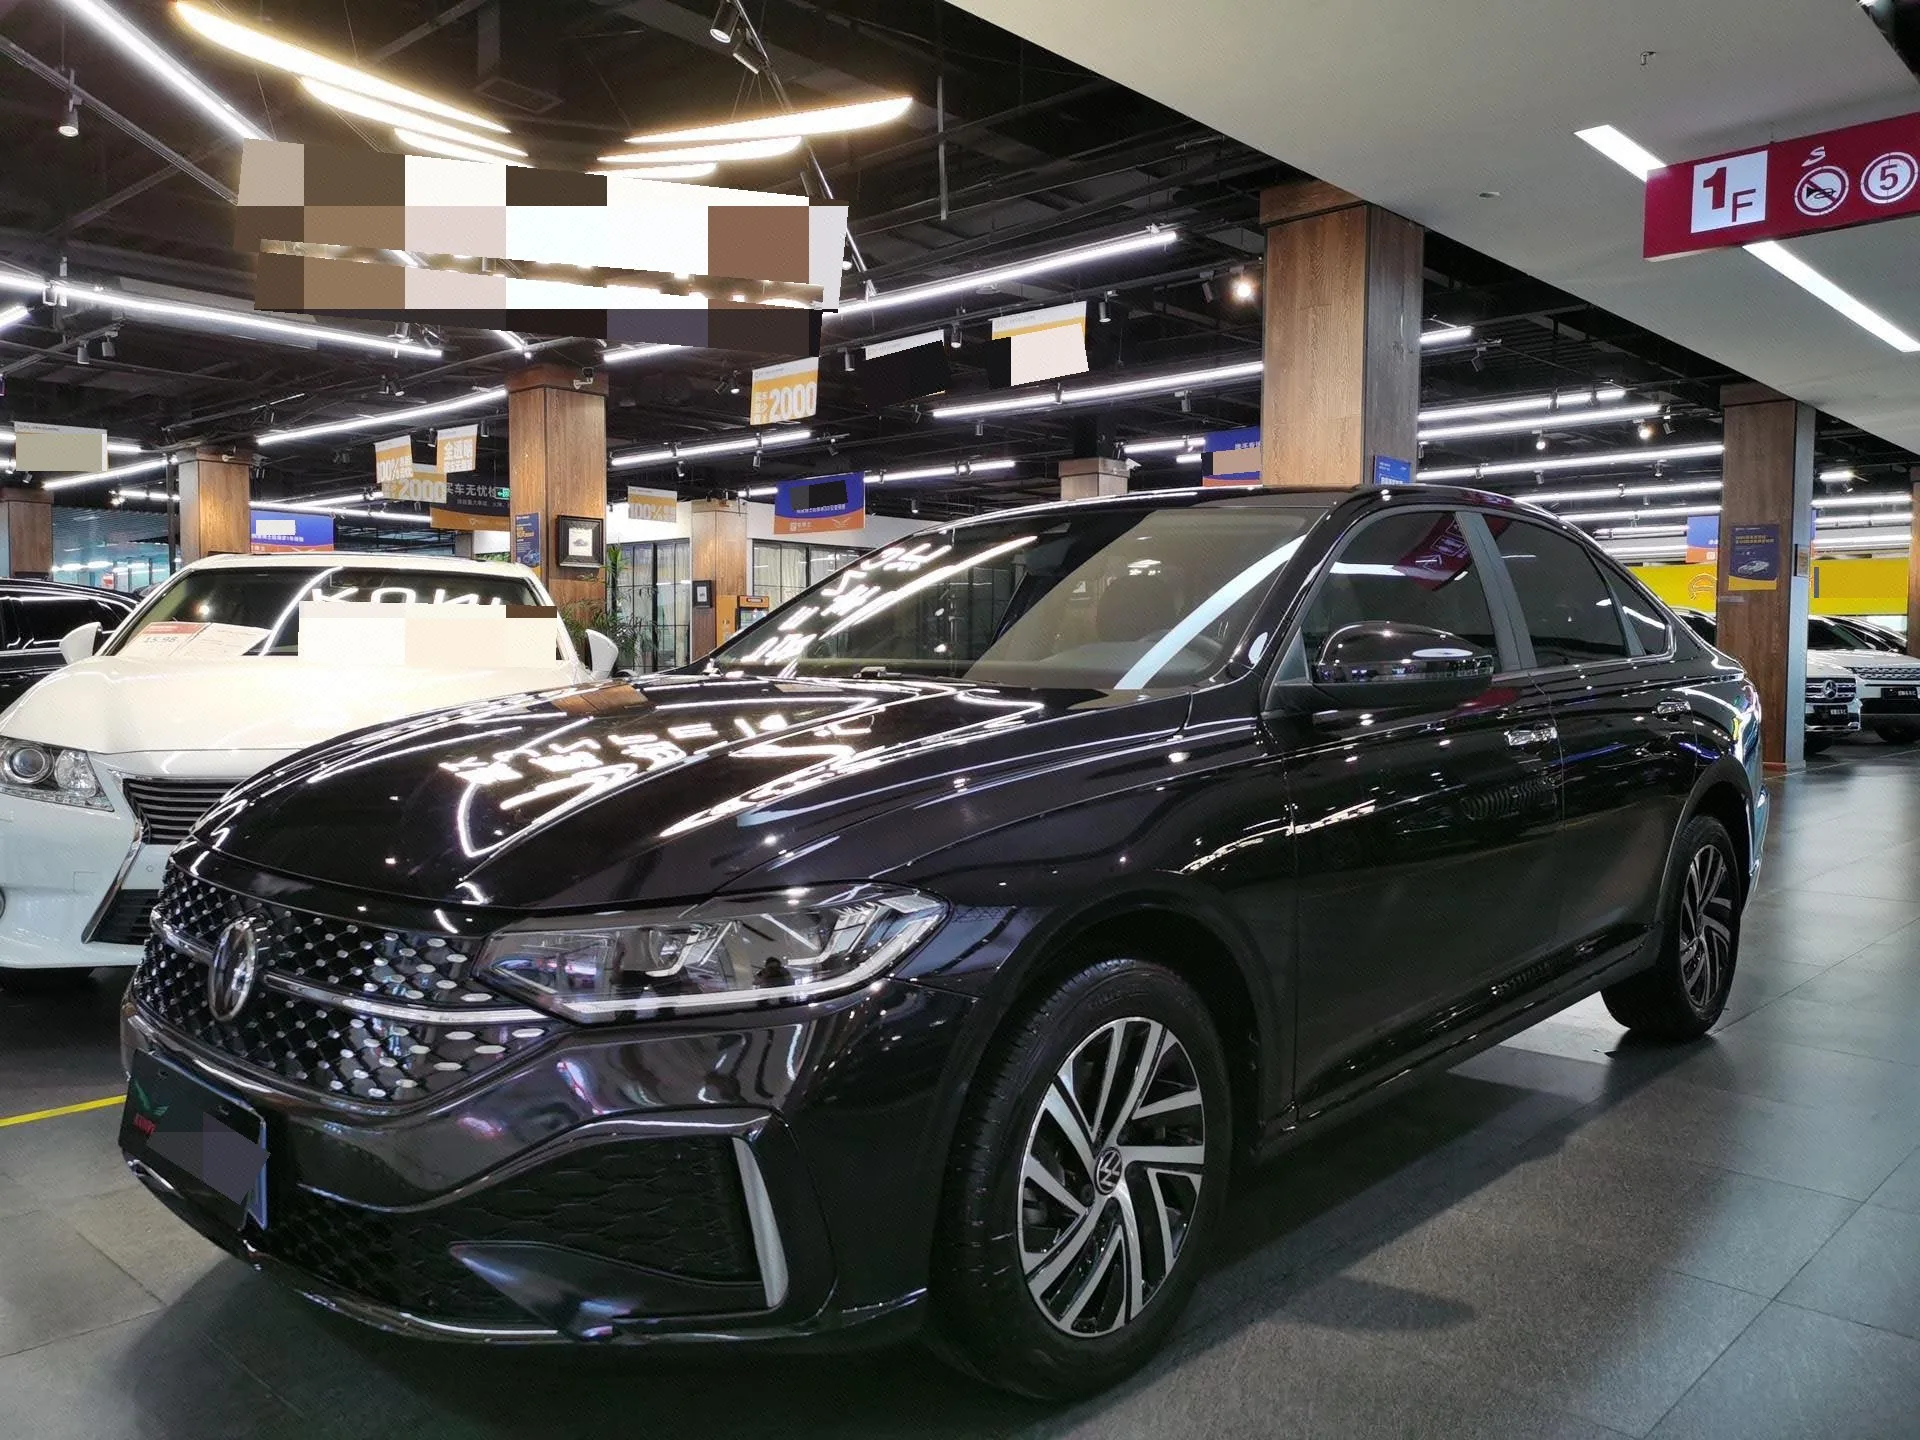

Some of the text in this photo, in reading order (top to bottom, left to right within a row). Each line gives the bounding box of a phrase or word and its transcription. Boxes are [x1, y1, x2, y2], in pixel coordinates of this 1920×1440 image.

[1703, 166, 1756, 223] 1F
[1879, 164, 1899, 192] 5
[770, 382, 817, 421] 2000
